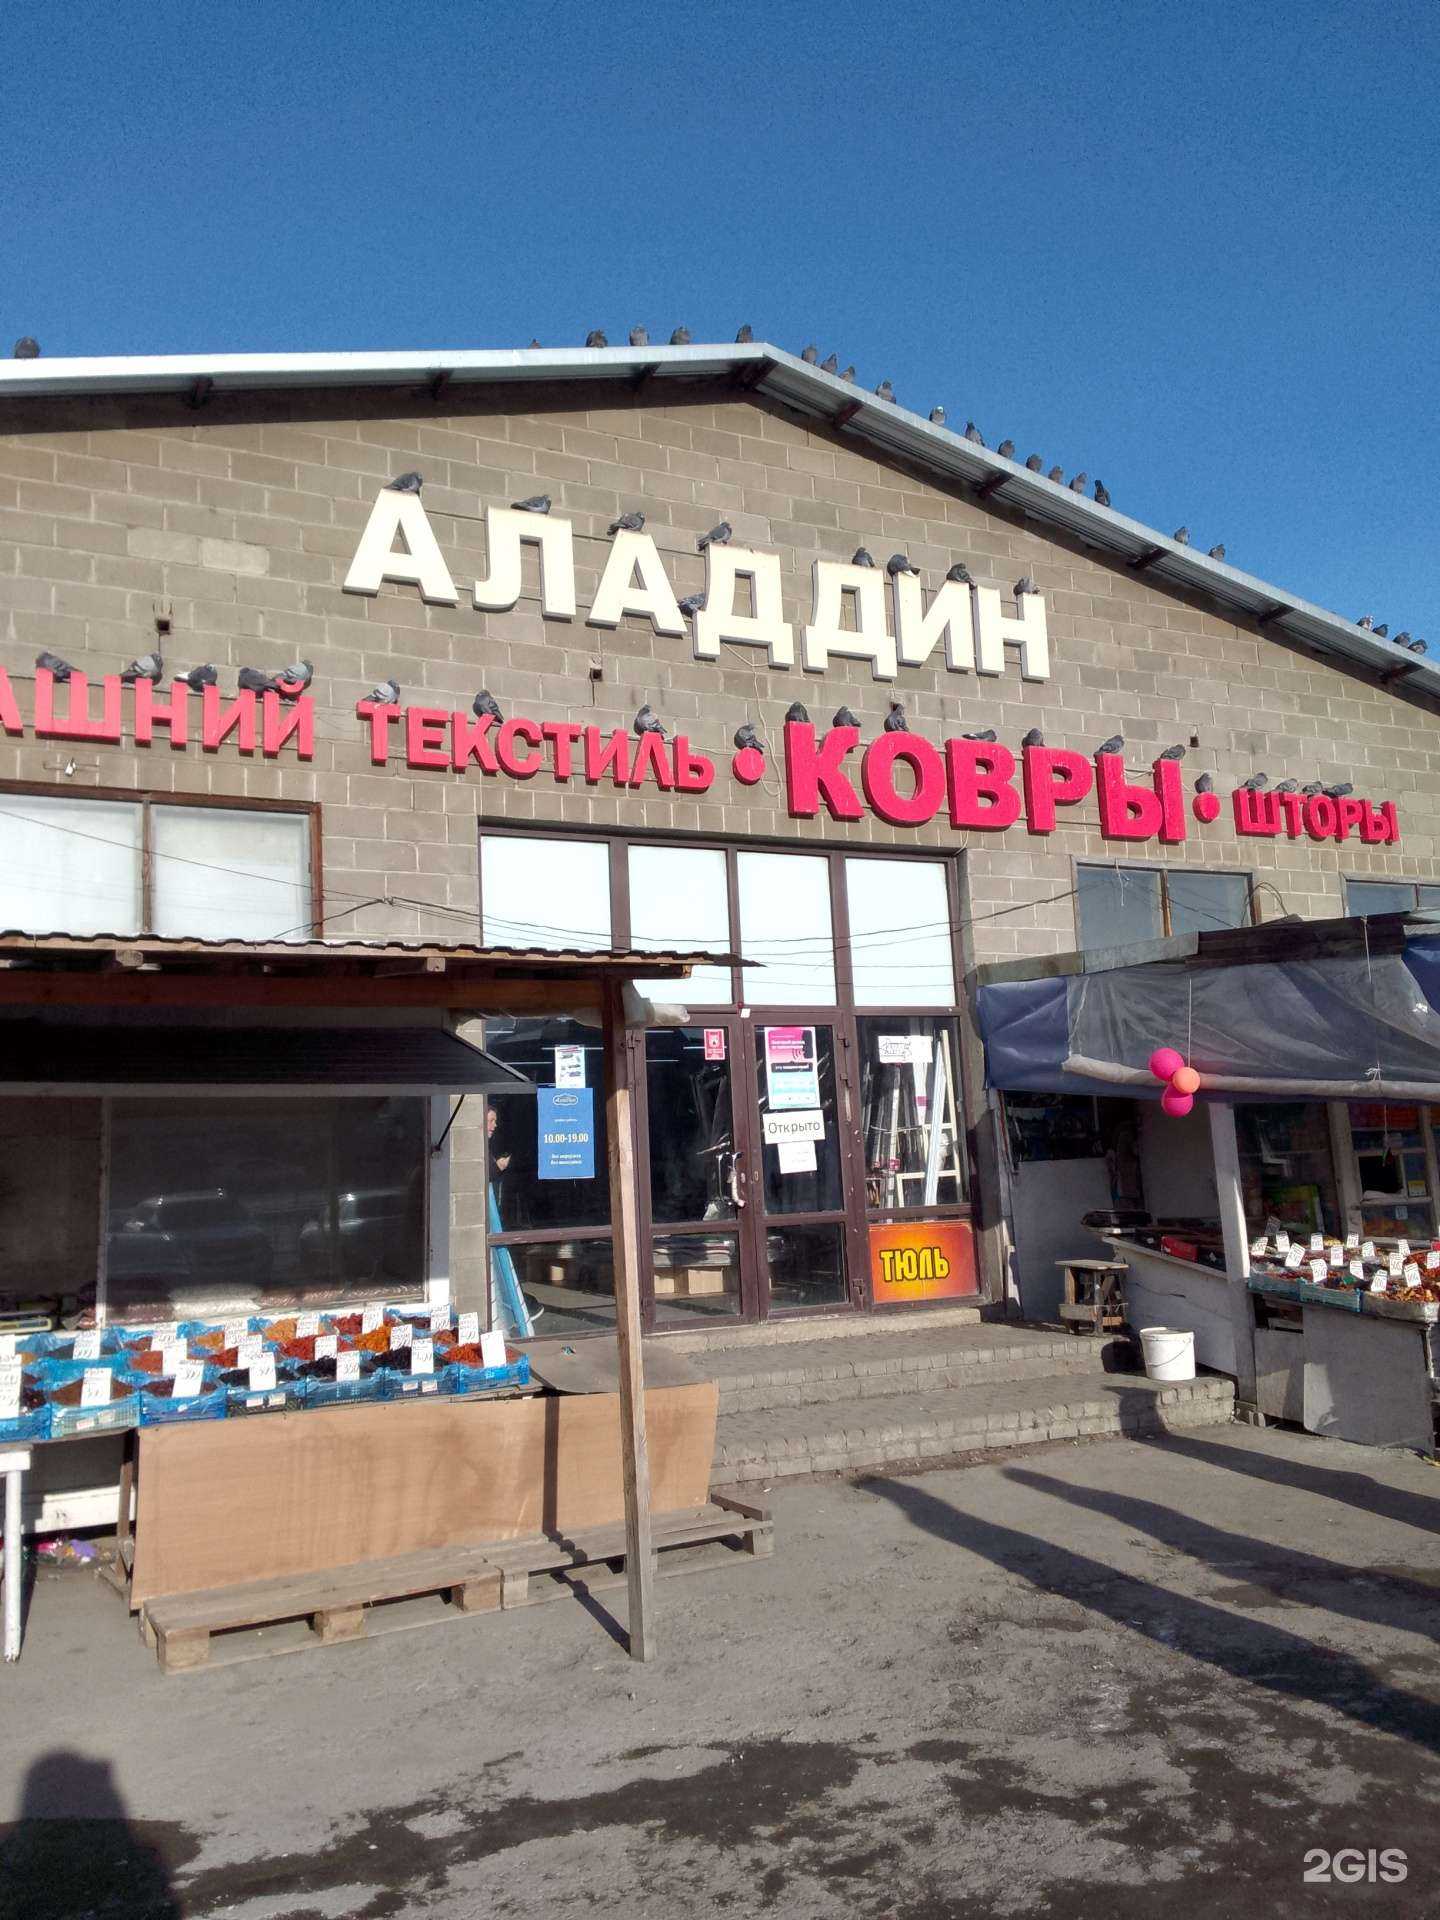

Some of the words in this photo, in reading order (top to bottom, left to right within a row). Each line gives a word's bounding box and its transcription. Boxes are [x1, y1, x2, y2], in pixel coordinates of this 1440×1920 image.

[343, 488, 1051, 682] АЛАДДИН
[357, 701, 716, 793] ТЕКСТИЛЬ
[784, 720, 1186, 843] КОВРЫ
[1231, 788, 1400, 845] ШТОРЫ
[543, 1132, 590, 1144] 10.00-19.00
[768, 1121, 821, 1135] Открыто
[879, 1247, 951, 1283] ТЮЛЬ
